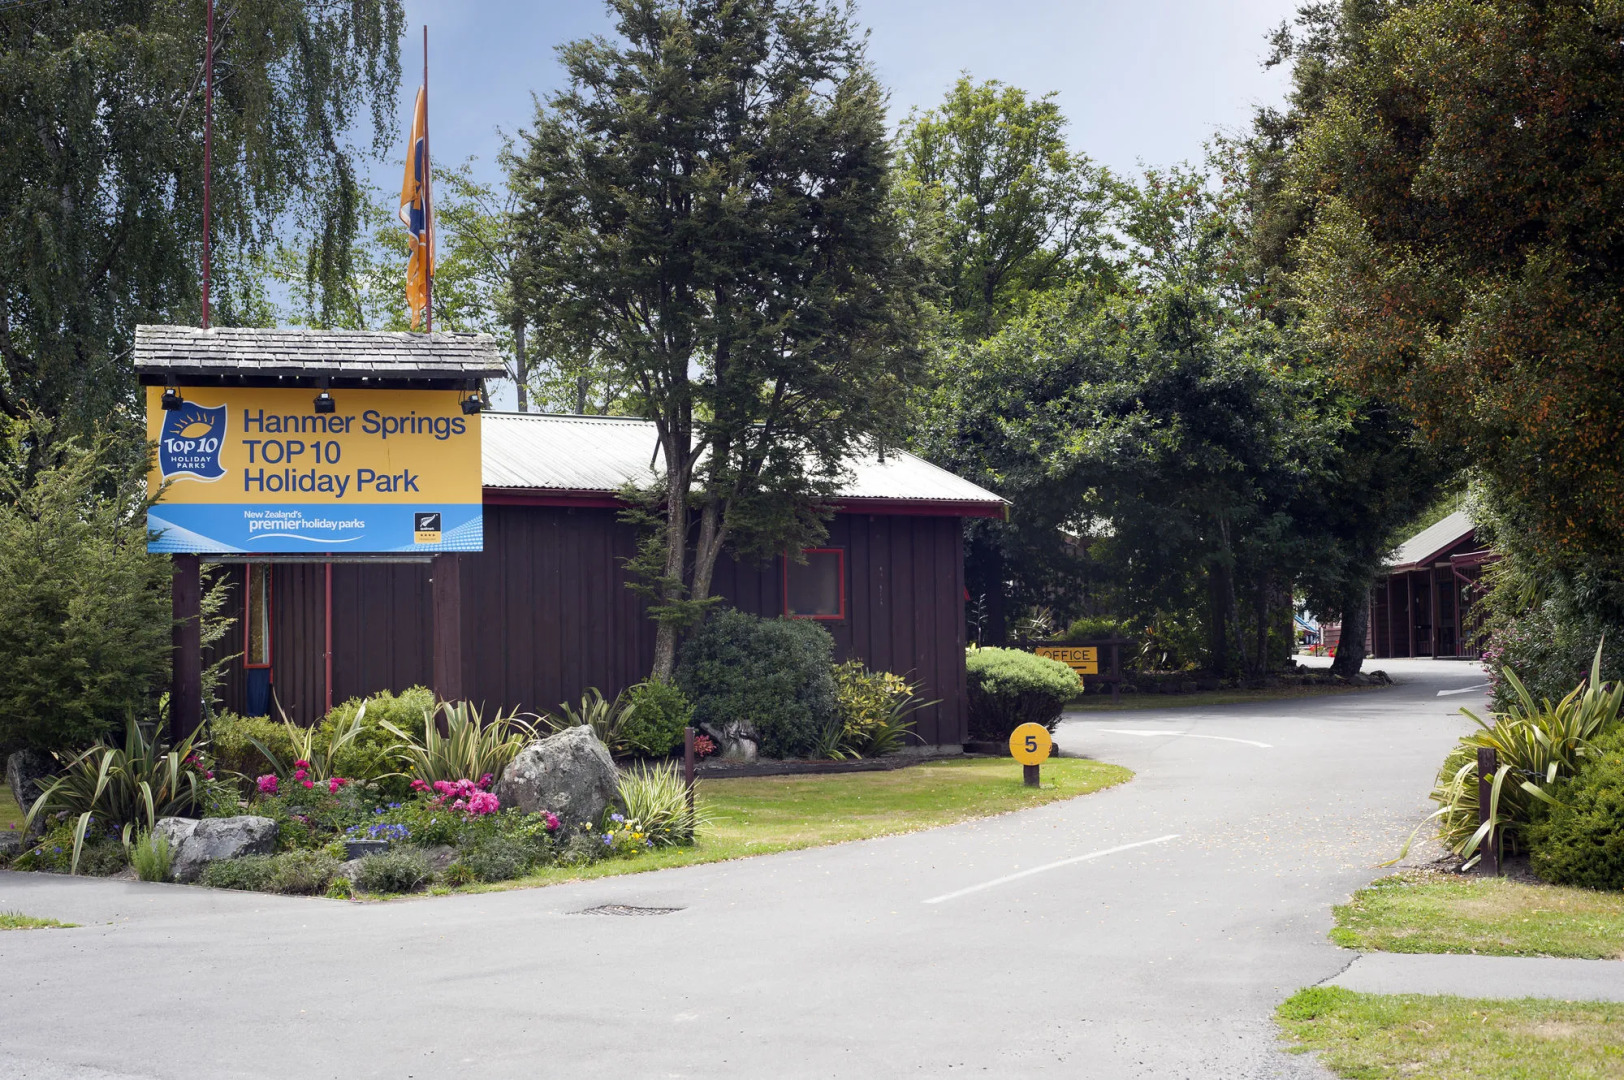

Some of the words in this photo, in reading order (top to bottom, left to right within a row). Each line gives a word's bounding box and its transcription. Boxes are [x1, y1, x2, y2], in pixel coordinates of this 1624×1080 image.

[243, 409, 355, 433] Hanmer
[362, 410, 466, 440] Springs
[196, 438, 218, 453] 10
[242, 440, 305, 464] TOP
[310, 440, 341, 464] 10
[244, 468, 350, 498] Holiday
[357, 469, 419, 492] Park
[244, 511, 263, 519] New
[264, 510, 302, 519] Zealand's
[249, 518, 301, 533] premier
[301, 519, 338, 531] holiday
[338, 519, 365, 530] parks
[1042, 650, 1090, 661] OFFICE
[1025, 736, 1038, 753] 5
